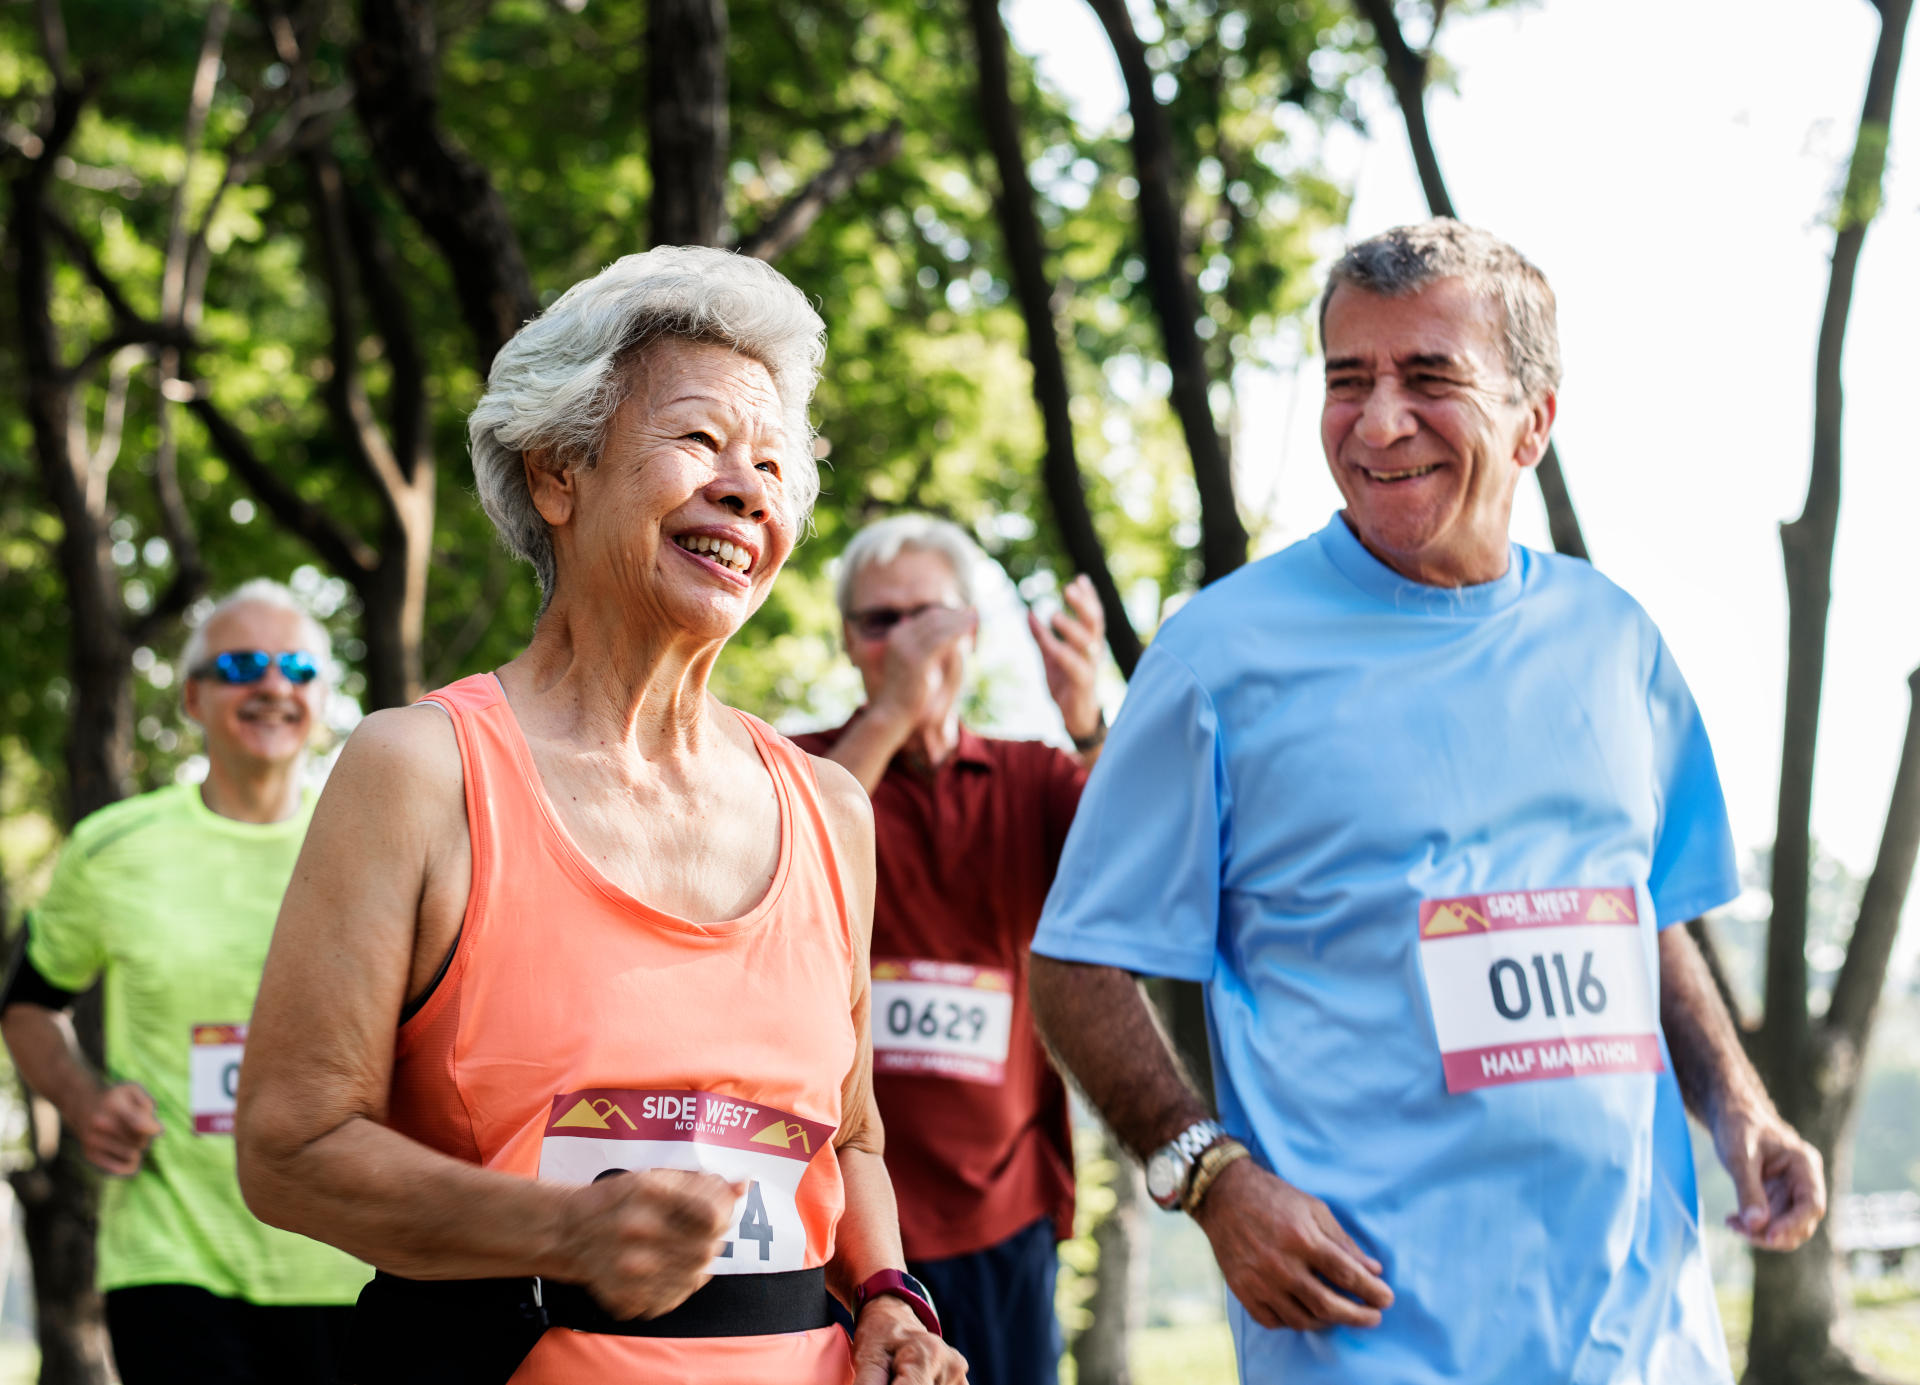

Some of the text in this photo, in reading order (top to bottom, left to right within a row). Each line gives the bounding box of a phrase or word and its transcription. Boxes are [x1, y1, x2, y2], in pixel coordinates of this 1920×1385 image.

[1489, 951, 1607, 1020] 0116
[887, 999, 986, 1042] 0629
[1480, 1042, 1637, 1078] HALF MARATHON
[642, 1096, 759, 1129] SIDE WEST
[675, 1121, 725, 1135] MOUNTAIN
